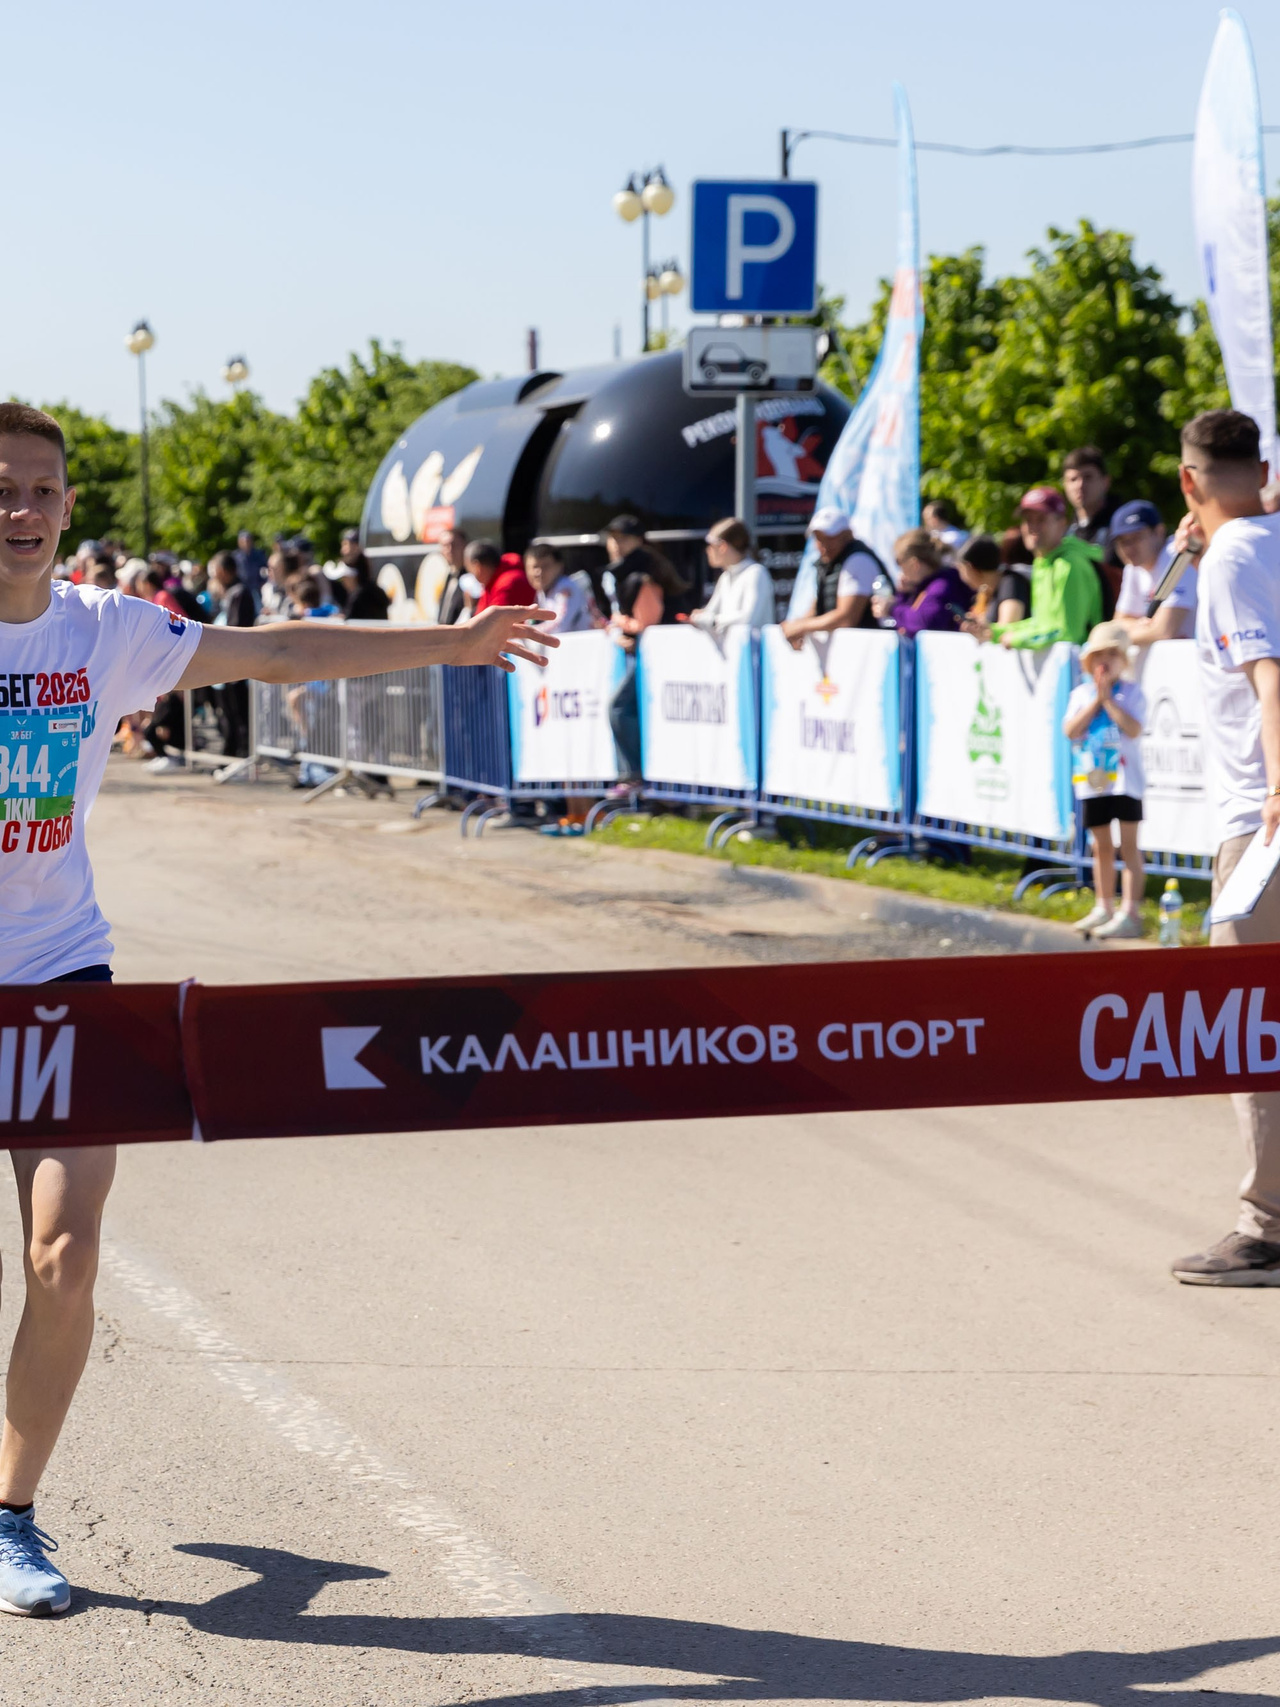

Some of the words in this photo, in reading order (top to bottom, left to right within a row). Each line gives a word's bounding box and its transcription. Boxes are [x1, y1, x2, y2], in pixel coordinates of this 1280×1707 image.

[726, 193, 795, 300] P
[1, 820, 22, 854] С
[26, 815, 73, 854] ТОБО
[419, 1024, 799, 1075] КАЛАШНИКОВ
[816, 1018, 986, 1062] СПОРТ
